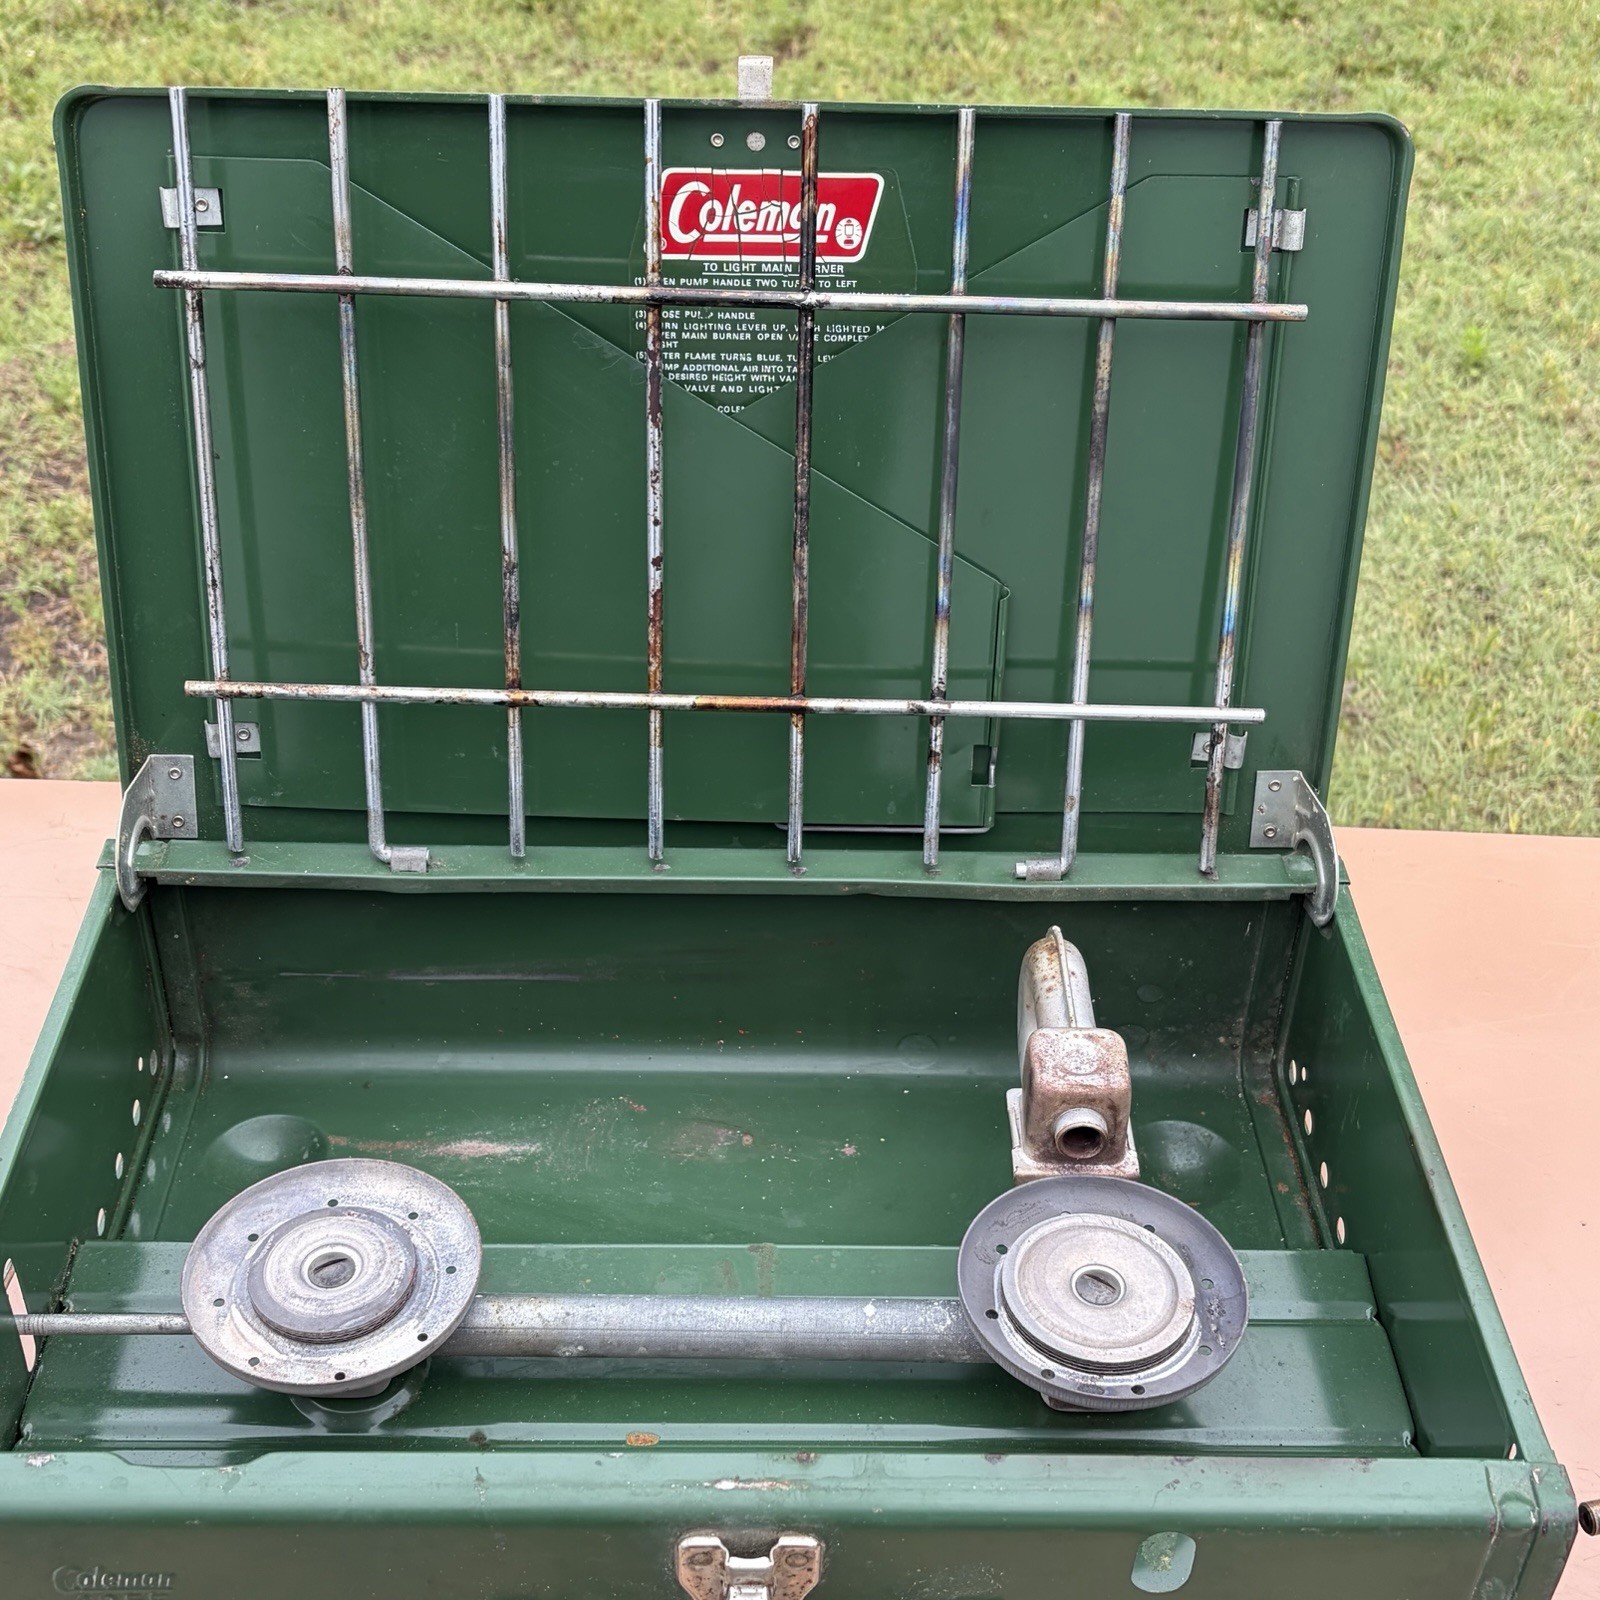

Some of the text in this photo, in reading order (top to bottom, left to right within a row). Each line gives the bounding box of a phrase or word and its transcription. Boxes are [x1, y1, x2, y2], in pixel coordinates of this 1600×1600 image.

[703, 262, 844, 274] TO LIGHT MAIN RNER
[680, 278, 709, 286] PUMP
[712, 278, 752, 287] HANDLE
[755, 279, 778, 287] TWO
[819, 280, 831, 288] TO
[836, 280, 857, 288] LEFT
[717, 312, 756, 320] HANDLE
[683, 323, 732, 331] LIGHTING
[736, 323, 767, 331] LEVER
[826, 324, 871, 333] LIGHTED
[681, 332, 708, 340] MAIN
[757, 333, 783, 341] OPEN
[721, 353, 752, 361] TURNS
[682, 364, 740, 372] ADDITIONAL
[761, 365, 784, 373] INTO
[668, 373, 708, 381] DESIRED
[712, 374, 748, 382] HEIGHT
[750, 374, 775, 382] WITH
[684, 384, 716, 393] VALVE
